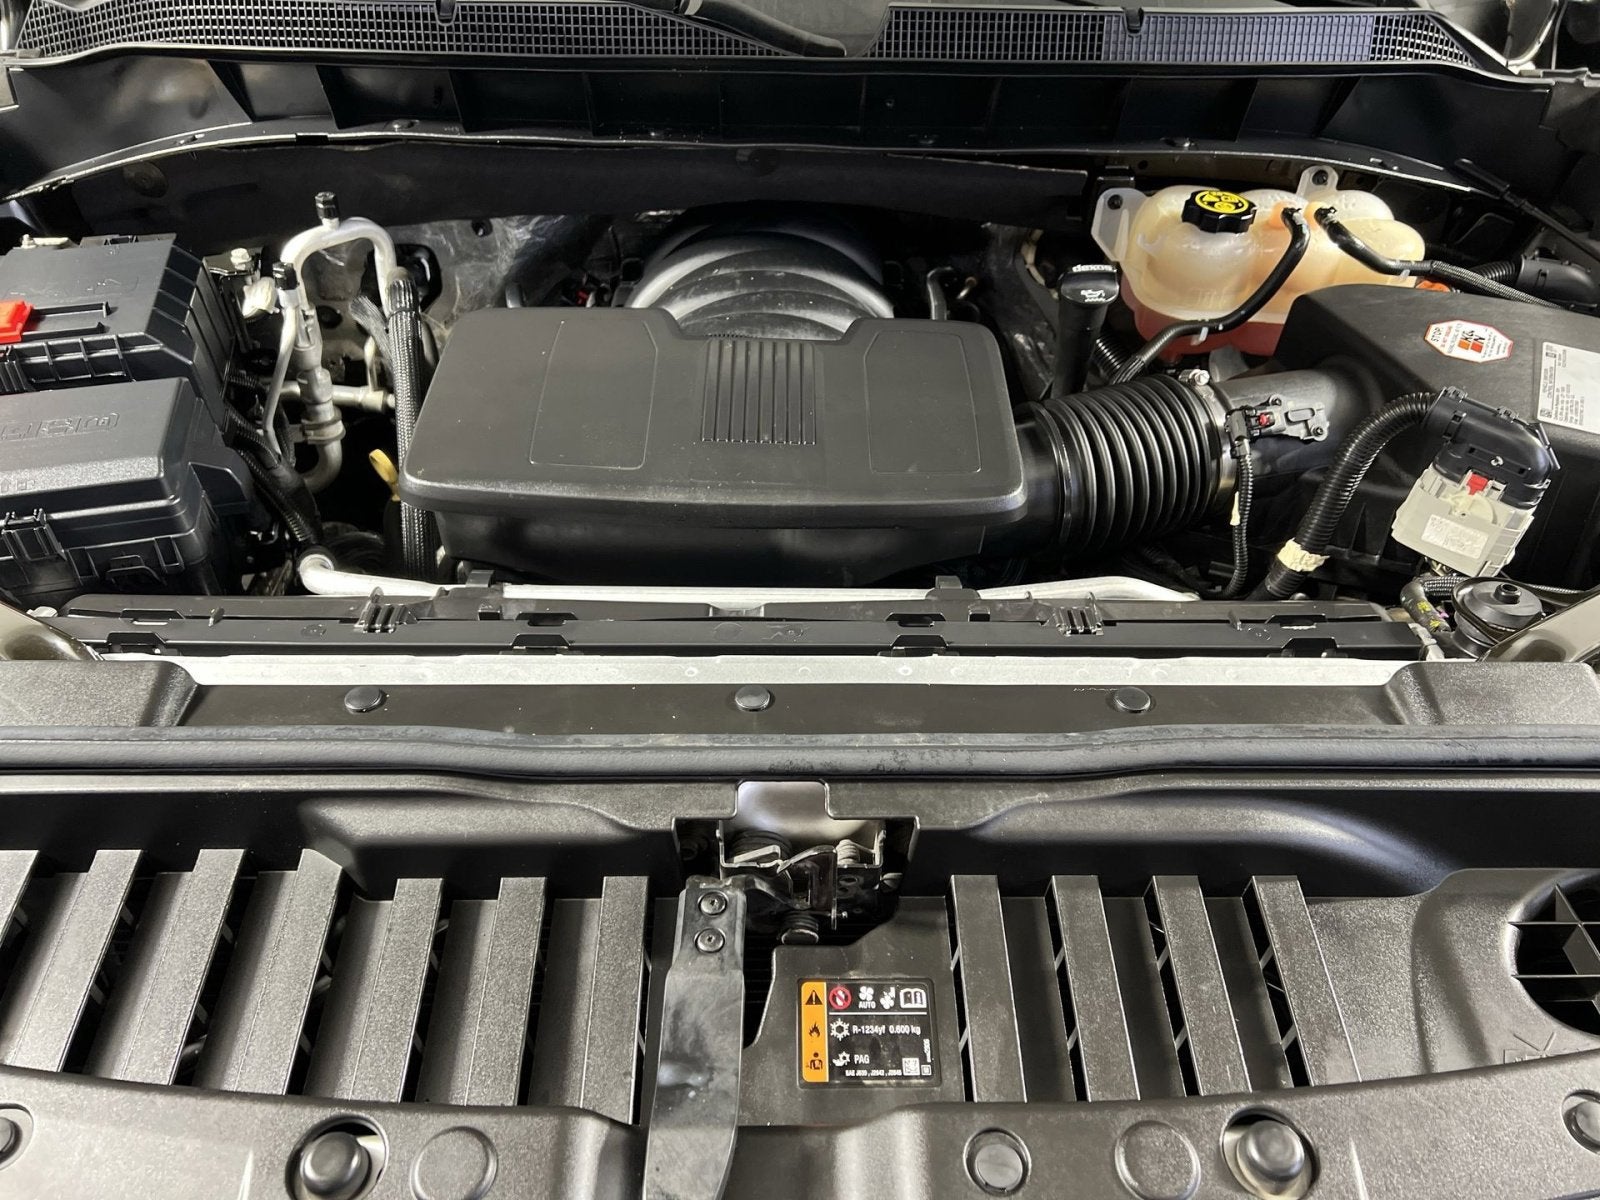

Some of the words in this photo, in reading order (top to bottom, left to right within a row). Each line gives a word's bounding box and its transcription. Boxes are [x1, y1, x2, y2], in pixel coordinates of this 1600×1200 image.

[858, 1000, 876, 1009] AUTO
[852, 1024, 886, 1036] R-1234yf
[910, 1024, 921, 1036] kg
[853, 1054, 870, 1065] PAG
